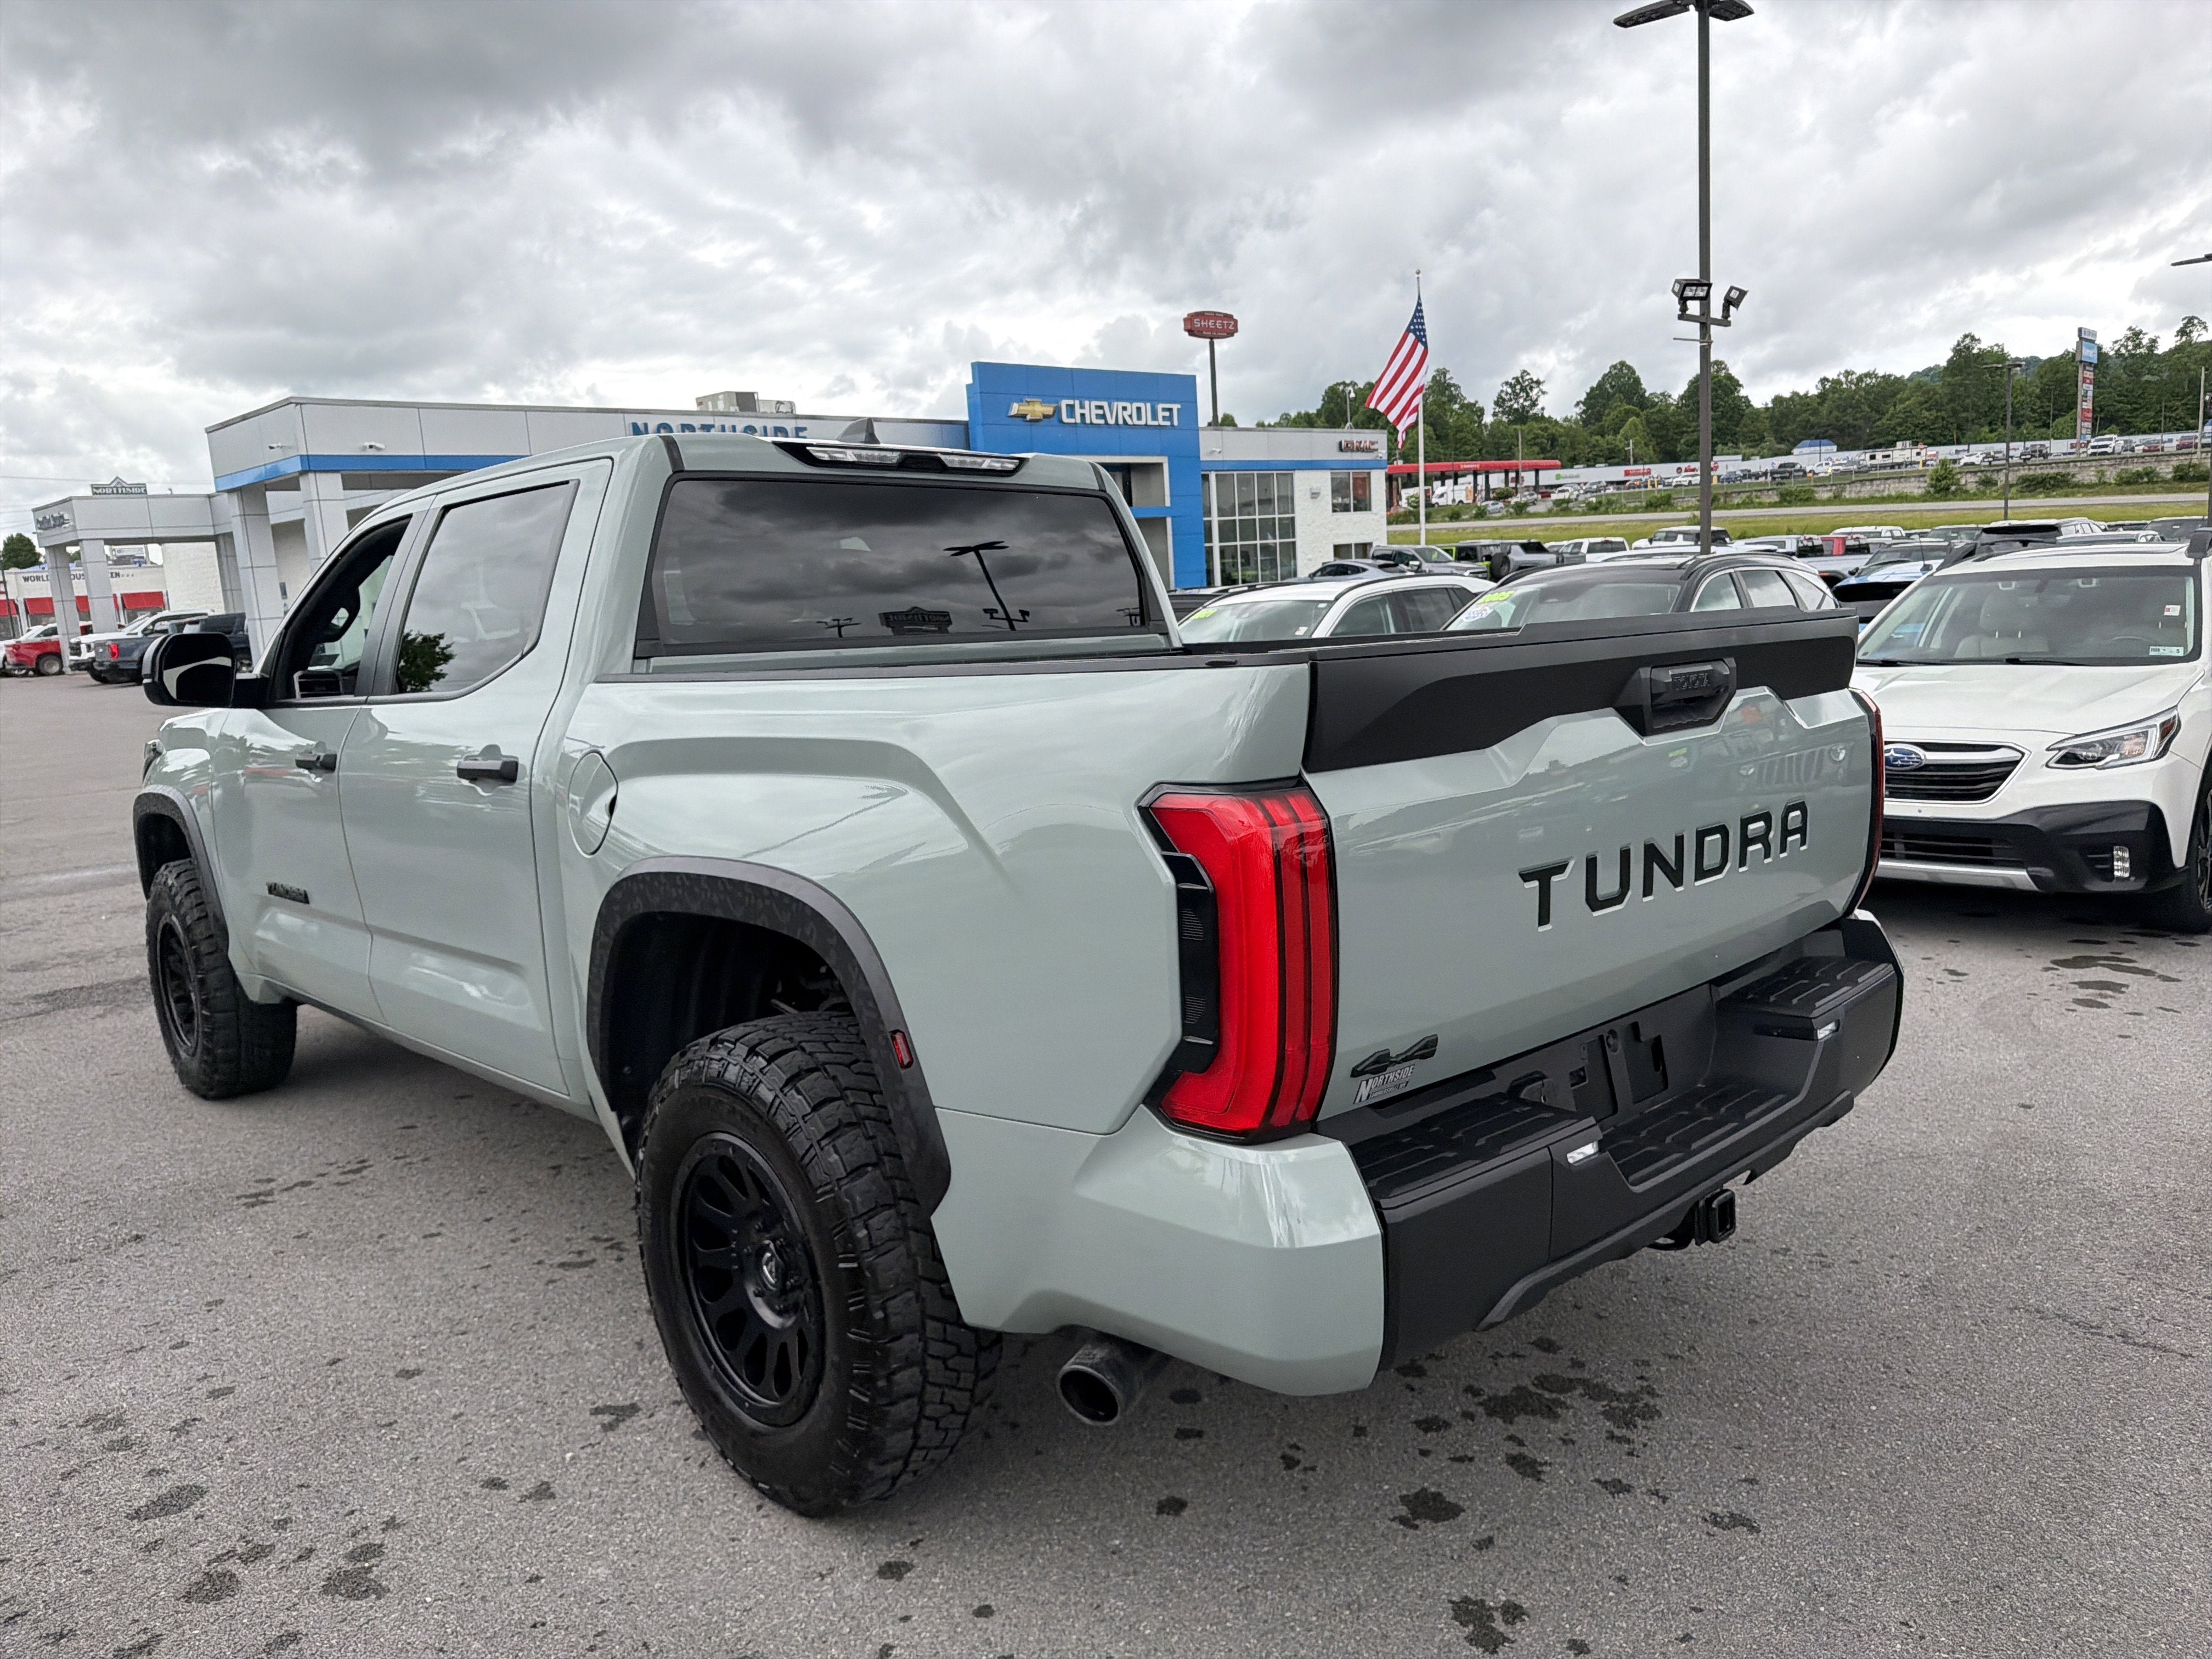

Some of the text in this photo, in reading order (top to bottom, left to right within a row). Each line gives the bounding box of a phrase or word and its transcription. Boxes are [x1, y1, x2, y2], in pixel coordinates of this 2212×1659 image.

[1194, 318, 1235, 330] SHEETZ
[1060, 399, 1181, 426] CHEVROLET
[1519, 799, 1808, 932] TUNDRA
[1354, 1065, 1415, 1104] NORTHSIDE
